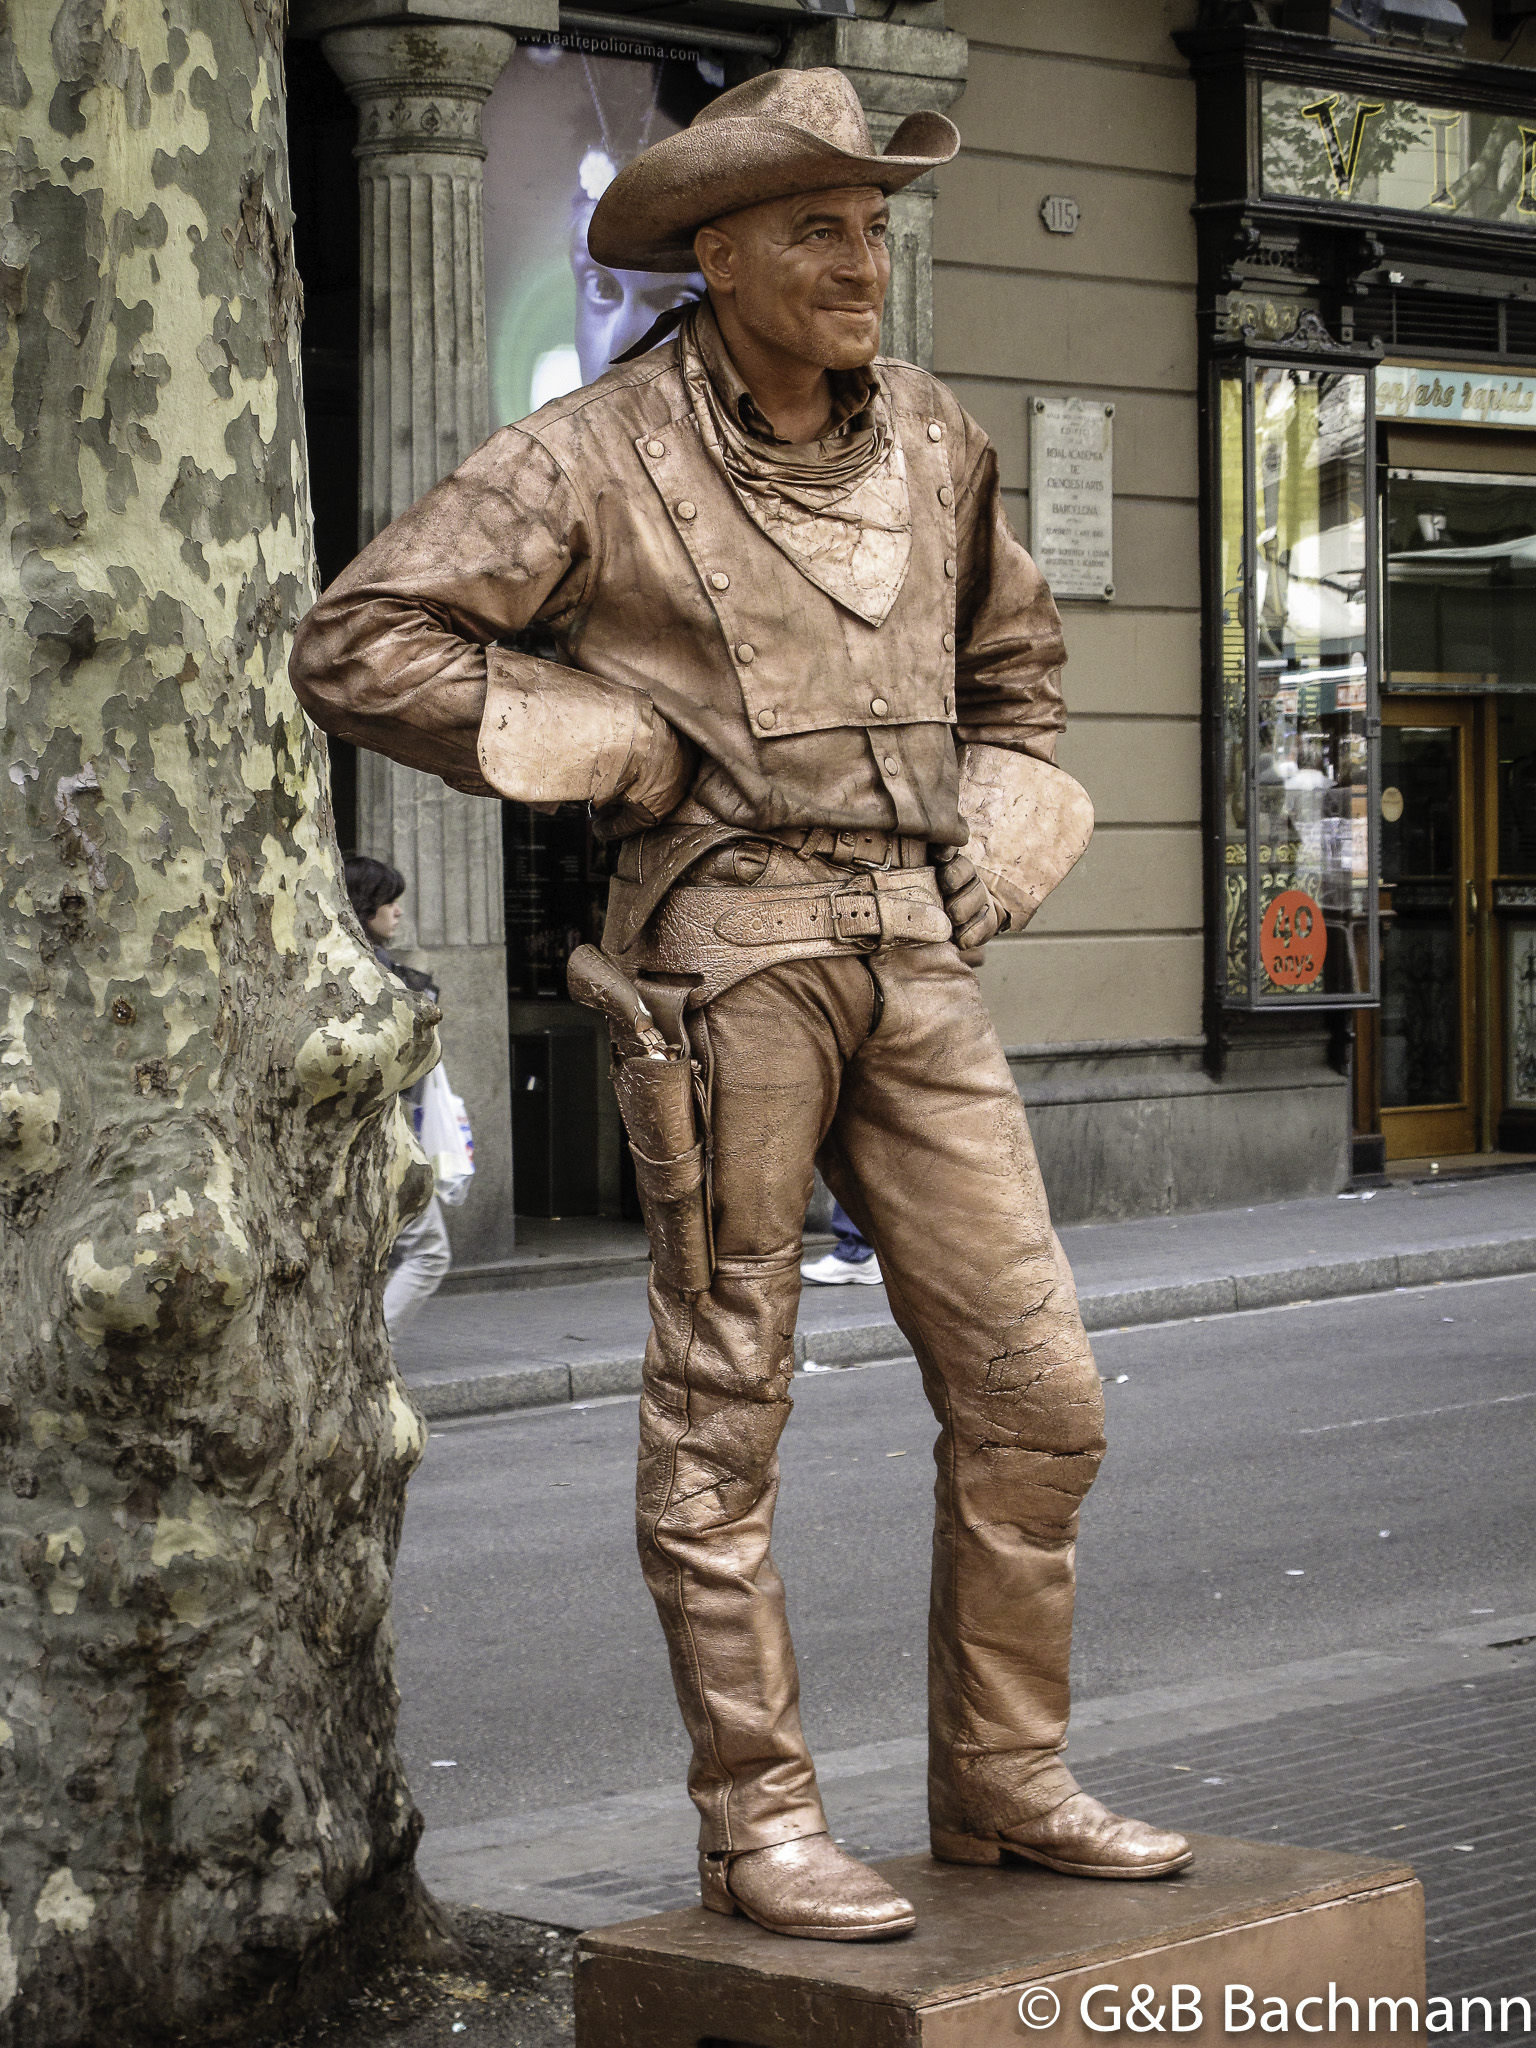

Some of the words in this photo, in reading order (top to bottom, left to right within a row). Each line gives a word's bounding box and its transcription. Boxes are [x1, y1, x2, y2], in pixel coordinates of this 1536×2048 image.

[519, 32, 700, 62] w.teatrepoliorama.com
[1051, 201, 1074, 228] 115
[1376, 374, 1455, 416] enjars
[1462, 381, 1533, 421] rapids
[1272, 904, 1314, 949] 40
[1273, 953, 1315, 979] anys
